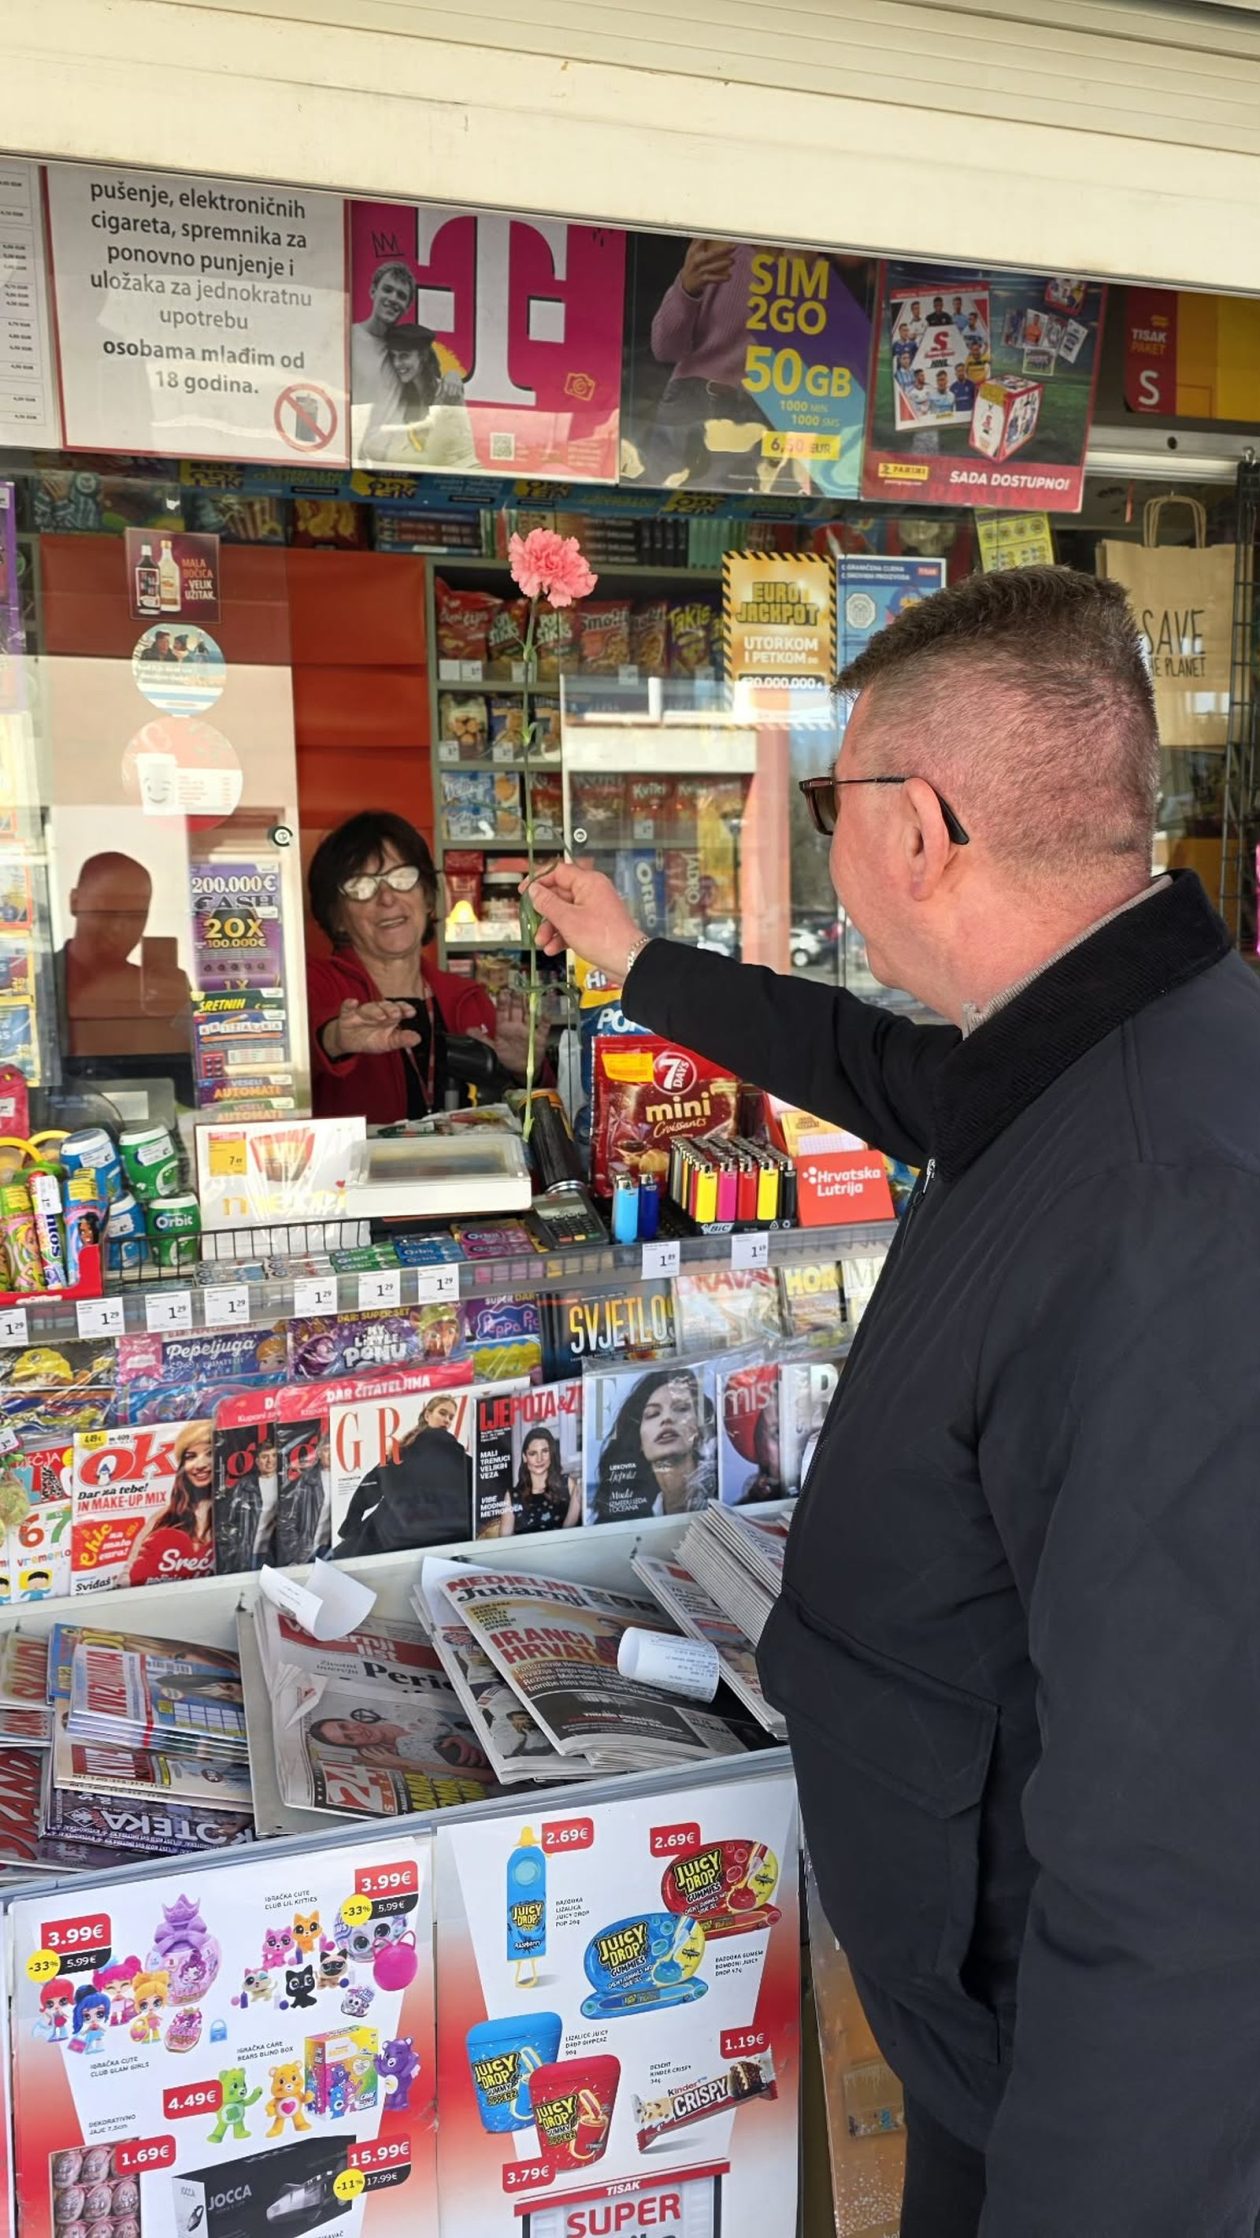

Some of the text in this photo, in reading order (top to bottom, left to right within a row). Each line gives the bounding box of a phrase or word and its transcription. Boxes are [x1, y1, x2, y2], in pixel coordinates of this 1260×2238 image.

[91, 181, 306, 219] pušenje, elektroničnih
[92, 211, 307, 248] cigareta, spremnika za
[108, 246, 294, 279] ponovno punjenje i
[749, 254, 830, 300] SIM
[91, 270, 312, 306] uložaka za jednokratnu
[160, 309, 249, 330] upotrebu
[746, 296, 827, 335] 2GO
[1132, 328, 1167, 343] TISAK
[103, 338, 305, 369] osobama mlađim od
[1132, 342, 1166, 355] PAKET
[156, 371, 259, 394] 18 godina.
[1138, 370, 1160, 405] S
[780, 400, 807, 412] 1000
[792, 415, 819, 426] 1000
[950, 471, 1071, 490] SADA DOSTUPNO!
[182, 558, 206, 569] MALA
[736, 602, 819, 626] JACKPOT
[1142, 609, 1205, 656] SAVE
[744, 636, 818, 651] UTORKOM
[744, 652, 806, 664] I PETKOM
[1165, 657, 1206, 677] PLANET
[204, 917, 264, 939] 20X
[200, 999, 246, 1012] SRETNIH
[658, 1059, 681, 1090] 7
[673, 1061, 689, 1088] DAYS
[214, 1086, 281, 1099] AUTOMATI
[645, 1091, 711, 1122] mini
[817, 1167, 881, 1183] Hrvatska
[817, 1183, 863, 1197] Lutrija
[156, 1212, 193, 1230] Orbit
[167, 1337, 256, 1361] Pepeljuga
[326, 1375, 431, 1402] DAR ČITATELJIMA
[480, 1450, 498, 1458] MALI
[480, 1471, 499, 1479] VEZA
[78, 1483, 149, 1500] Dar za tebe!
[78, 1491, 167, 1512] IN MAKE-UP MIX
[490, 1628, 595, 1649] IRANCI
[357, 1644, 400, 1663] list
[326, 1762, 380, 1811] 24
[546, 1828, 588, 1845] 2.69€
[655, 1832, 695, 1849] 2.69€
[676, 1851, 719, 1887] JUICY
[361, 1870, 412, 1892] 3.99€
[686, 1869, 715, 1893] DROP
[687, 1883, 720, 1903] GUMMIES
[265, 1902, 282, 1910] CLUB
[378, 1901, 405, 1912] 5.99€
[513, 1904, 542, 1920] JUICY
[517, 1914, 539, 1926] DROP
[48, 1924, 104, 1946] 3.99€
[599, 1923, 647, 1961] JUICY
[66, 1955, 97, 1968] 5.99€
[610, 1943, 640, 1966] DROP
[611, 1956, 645, 1976] GUMMIES
[725, 2033, 764, 2050] 1.19€
[91, 2069, 108, 2078] CLUB
[475, 2053, 515, 2082] JUICY
[482, 2070, 511, 2088] DROP
[168, 2090, 216, 2110] 4.49€
[674, 2078, 728, 2116] CRISPY
[536, 2097, 574, 2123] JUICY
[89, 2114, 136, 2128] DEKORATIVNO
[542, 2114, 570, 2130] DROP
[121, 2145, 169, 2166] 1.69€
[350, 2142, 410, 2166] 15.99€
[366, 2172, 397, 2186] 17.99€
[507, 2165, 550, 2184] 3.79€
[207, 2184, 252, 2211] JOCCA
[606, 2181, 640, 2196] TISAK
[567, 2193, 681, 2238] SUPER
